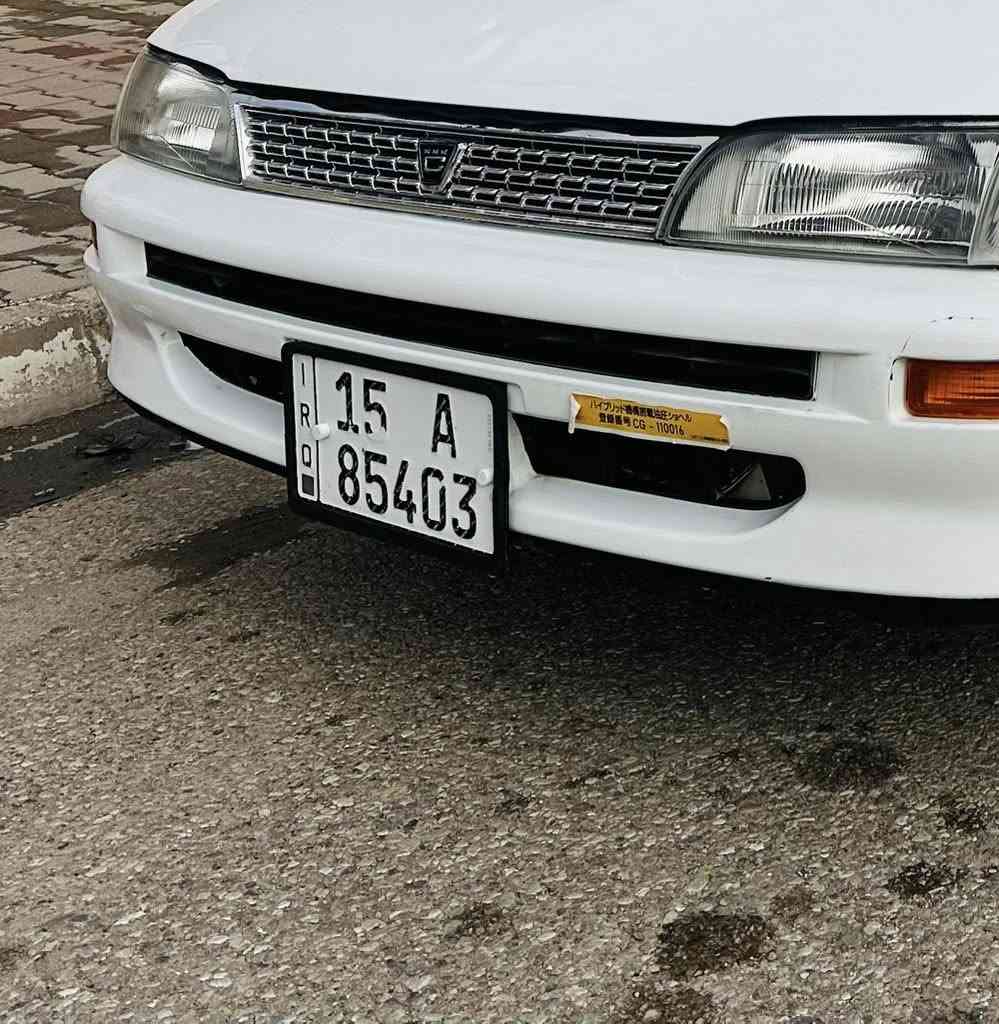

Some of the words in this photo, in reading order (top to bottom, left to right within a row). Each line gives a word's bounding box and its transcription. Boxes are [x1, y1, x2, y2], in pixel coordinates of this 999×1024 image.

[335, 371, 387, 435] 15
[431, 392, 457, 459] A
[337, 443, 478, 540] 85403
